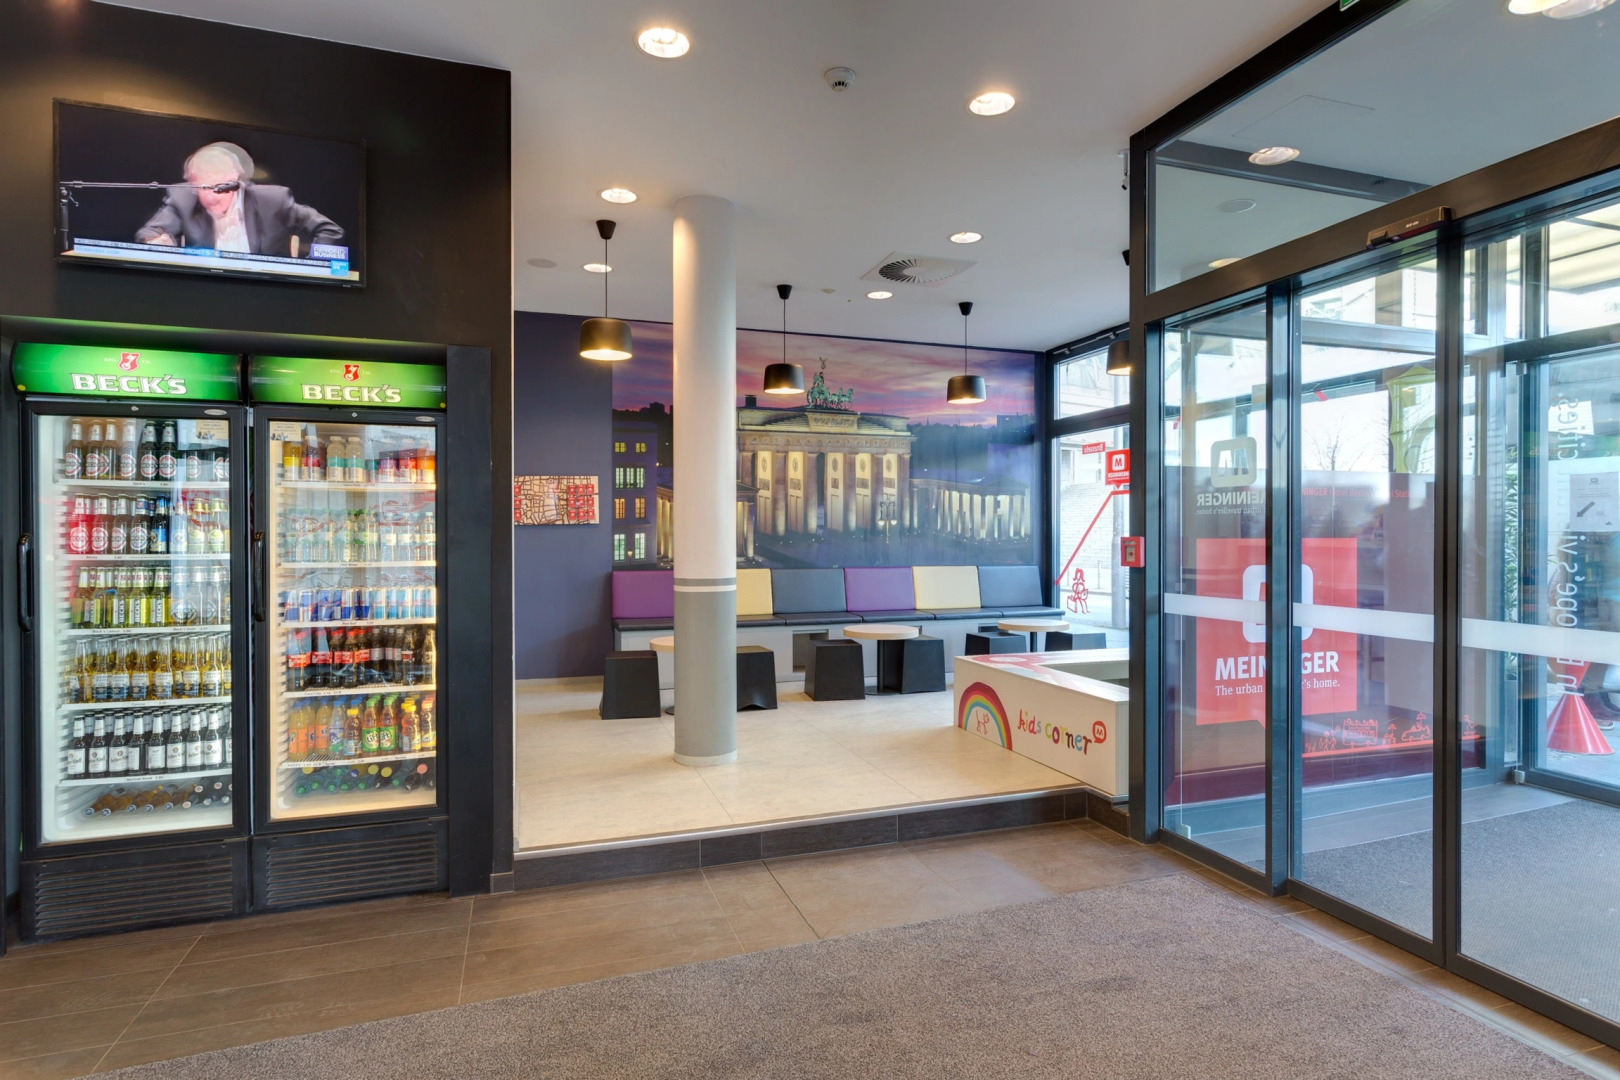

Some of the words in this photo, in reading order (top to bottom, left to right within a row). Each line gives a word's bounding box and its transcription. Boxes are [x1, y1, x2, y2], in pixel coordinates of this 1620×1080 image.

[70, 373, 187, 395] BECK'S
[301, 383, 402, 403] BECK'S
[1215, 685, 1233, 696] The
[1236, 683, 1263, 694] urban
[1313, 678, 1340, 689] home.
[1018, 709, 1041, 734] kids
[1045, 722, 1092, 755] corner
